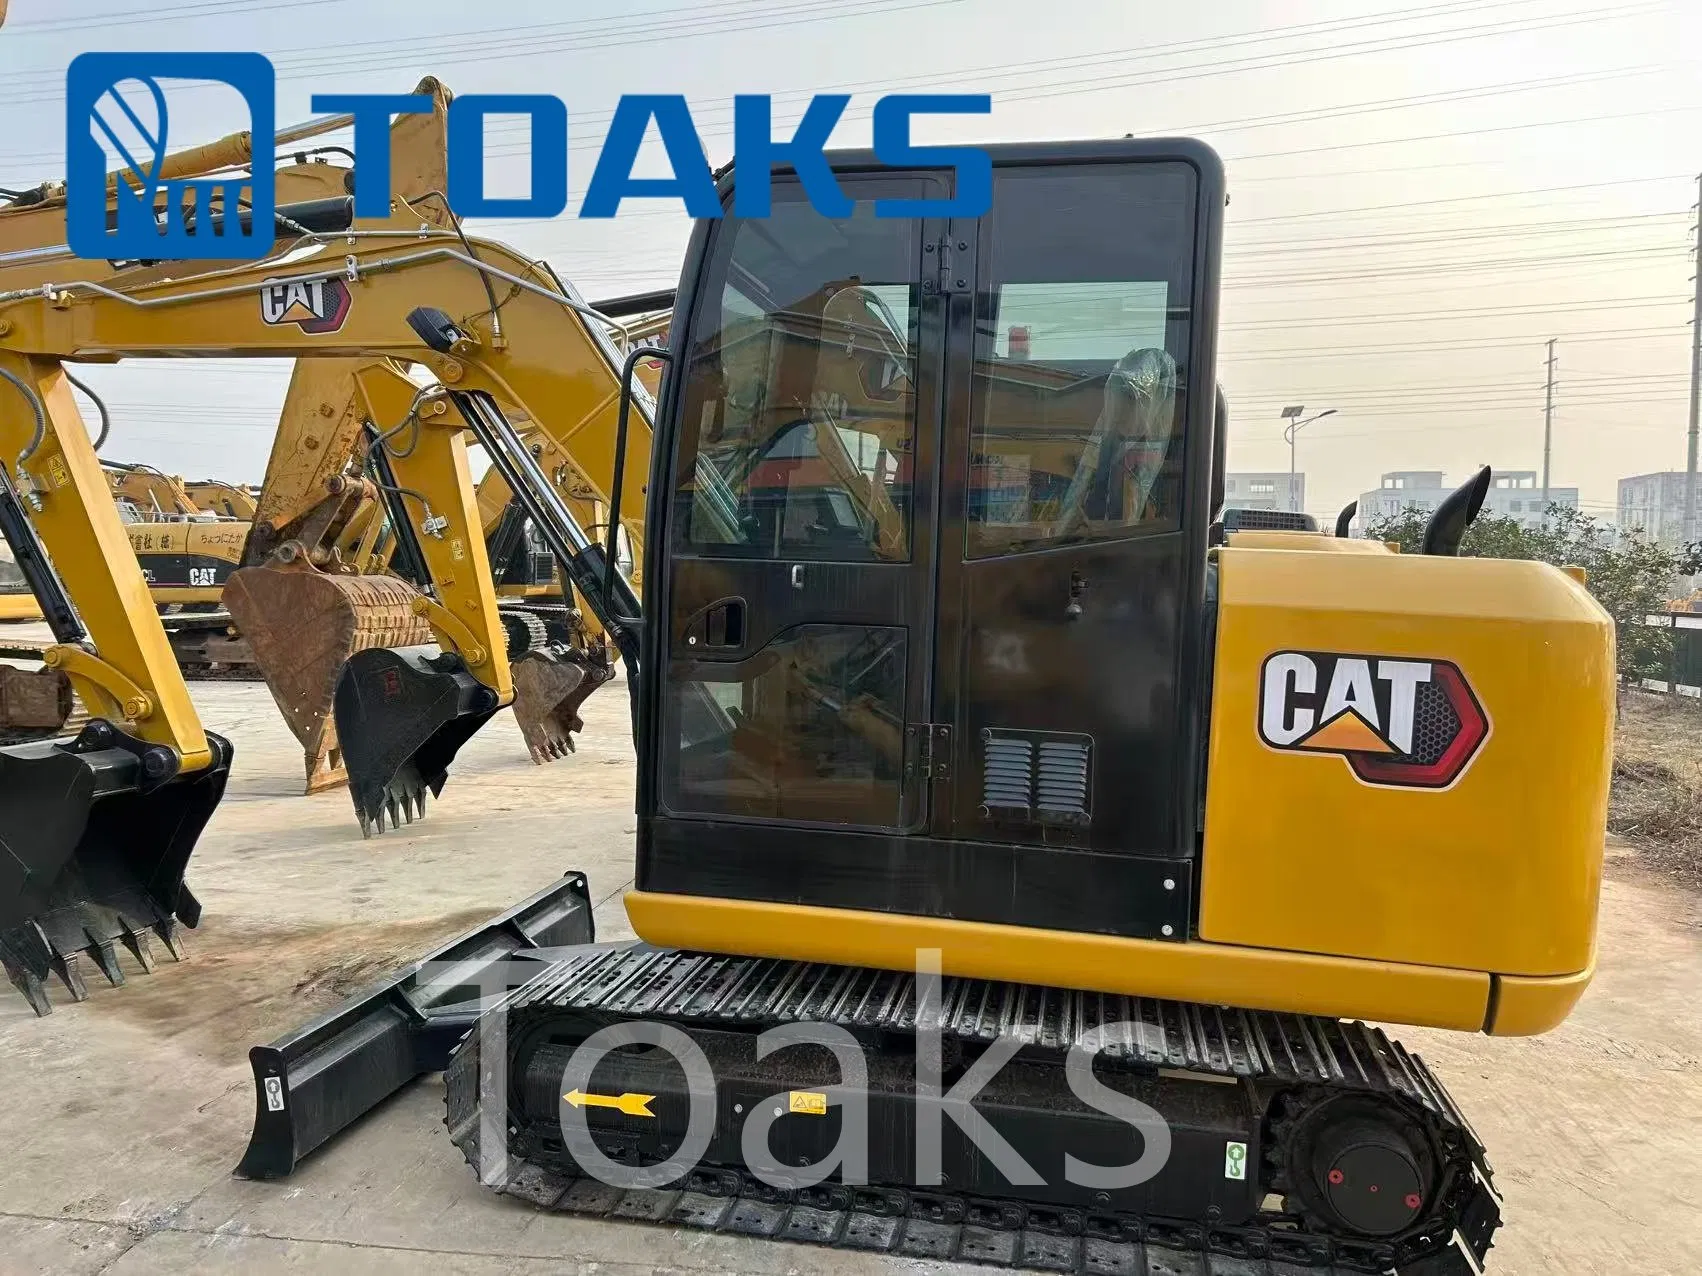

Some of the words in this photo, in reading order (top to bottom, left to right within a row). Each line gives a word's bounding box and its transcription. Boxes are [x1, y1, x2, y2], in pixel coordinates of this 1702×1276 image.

[262, 278, 327, 322] CAT
[189, 567, 217, 586] CAT
[1262, 653, 1432, 755] CAT
